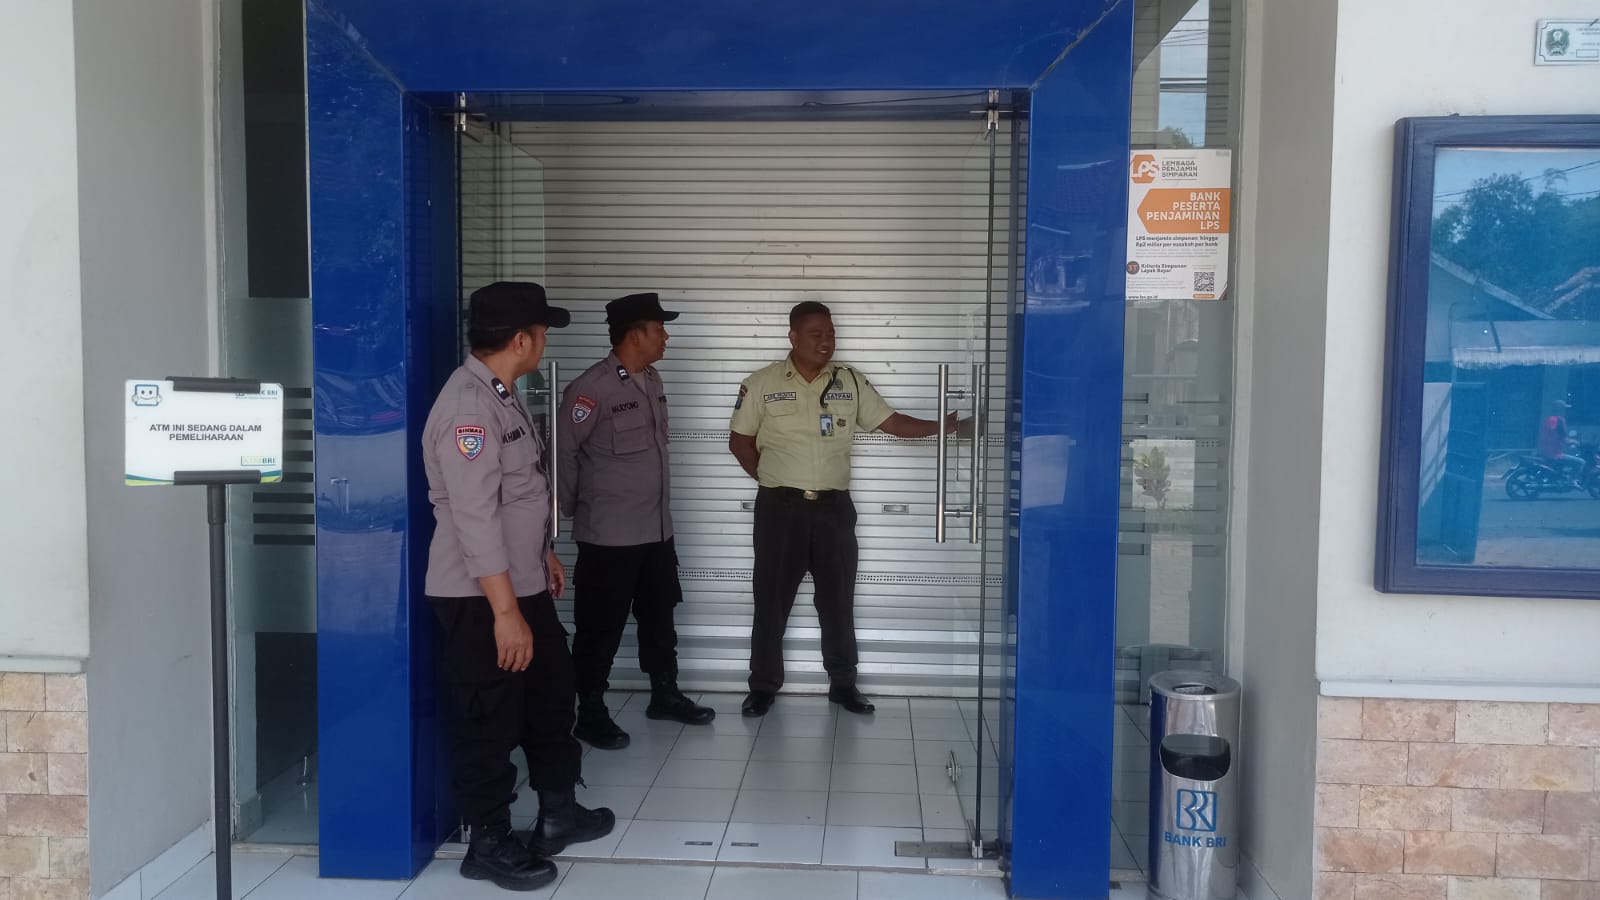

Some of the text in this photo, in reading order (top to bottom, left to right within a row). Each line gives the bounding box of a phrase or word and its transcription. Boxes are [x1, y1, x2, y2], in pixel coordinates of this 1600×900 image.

[1131, 161, 1159, 178] LPS
[1190, 191, 1221, 201] BANK
[1173, 201, 1220, 211] PESERTA
[1146, 211, 1220, 221] PENJAMINAN
[1200, 221, 1220, 230] LPS
[149, 424, 262, 432] ATM INI SEDANG DALAM
[169, 433, 244, 441] PEMELIHARAAN
[1164, 831, 1227, 848] BANK BRI
